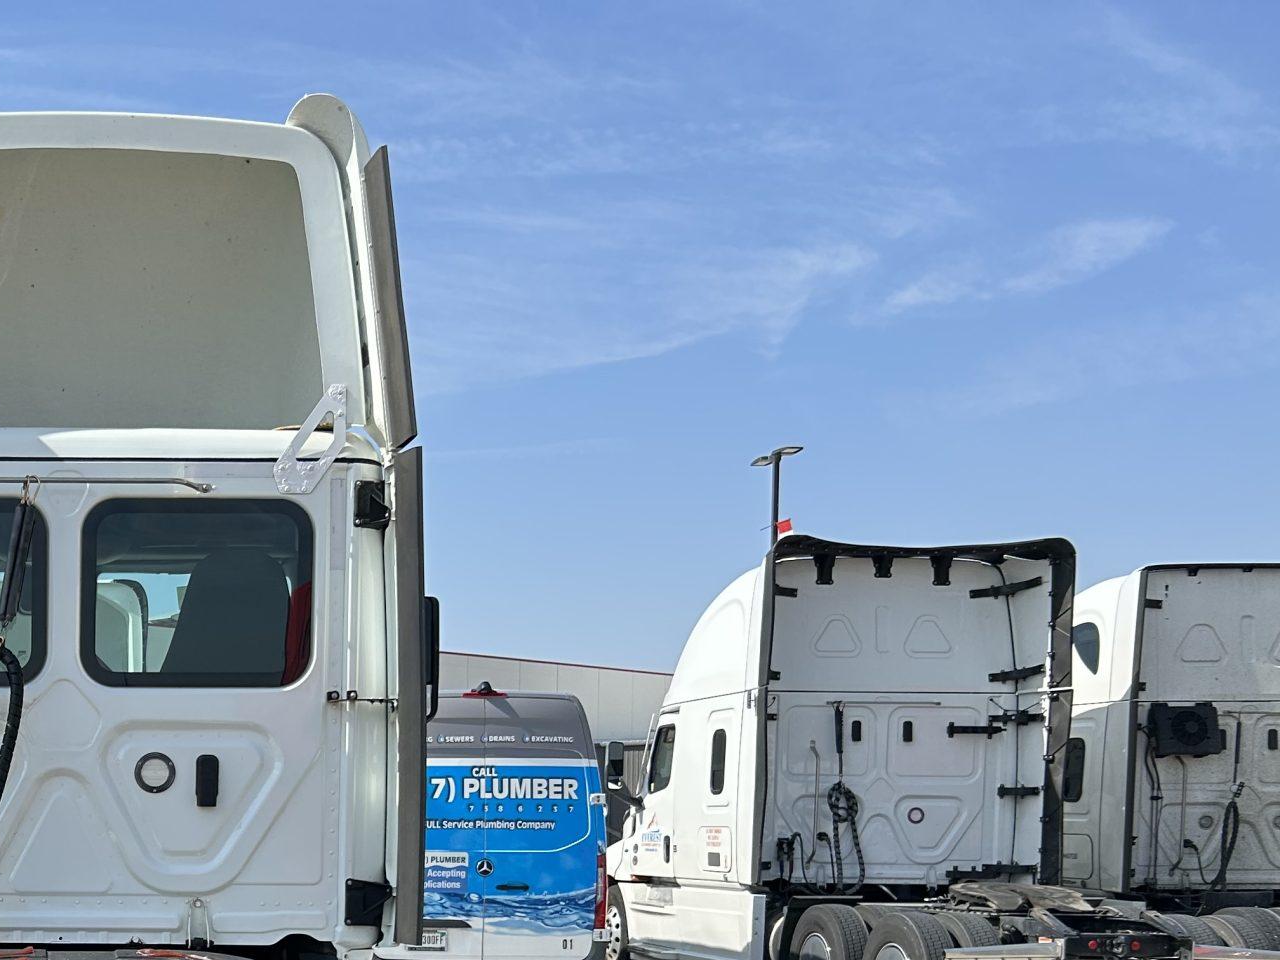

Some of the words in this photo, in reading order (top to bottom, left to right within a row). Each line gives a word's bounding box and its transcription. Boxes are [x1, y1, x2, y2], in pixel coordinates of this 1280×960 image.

[445, 735, 475, 743] SEWERS
[488, 735, 516, 743] DRAINS
[531, 735, 575, 743] EXCAVATING
[472, 767, 498, 777] CALL
[430, 777, 456, 803] 7)
[463, 778, 579, 800] PLUMBER
[425, 820, 441, 829] ULL
[442, 820, 474, 829] Service
[475, 820, 515, 831] Plumbing
[516, 820, 556, 831] Company
[430, 856, 466, 864] PLUMBER
[427, 868, 466, 878] Accepting
[423, 881, 461, 891] plications
[562, 938, 574, 950] 01
